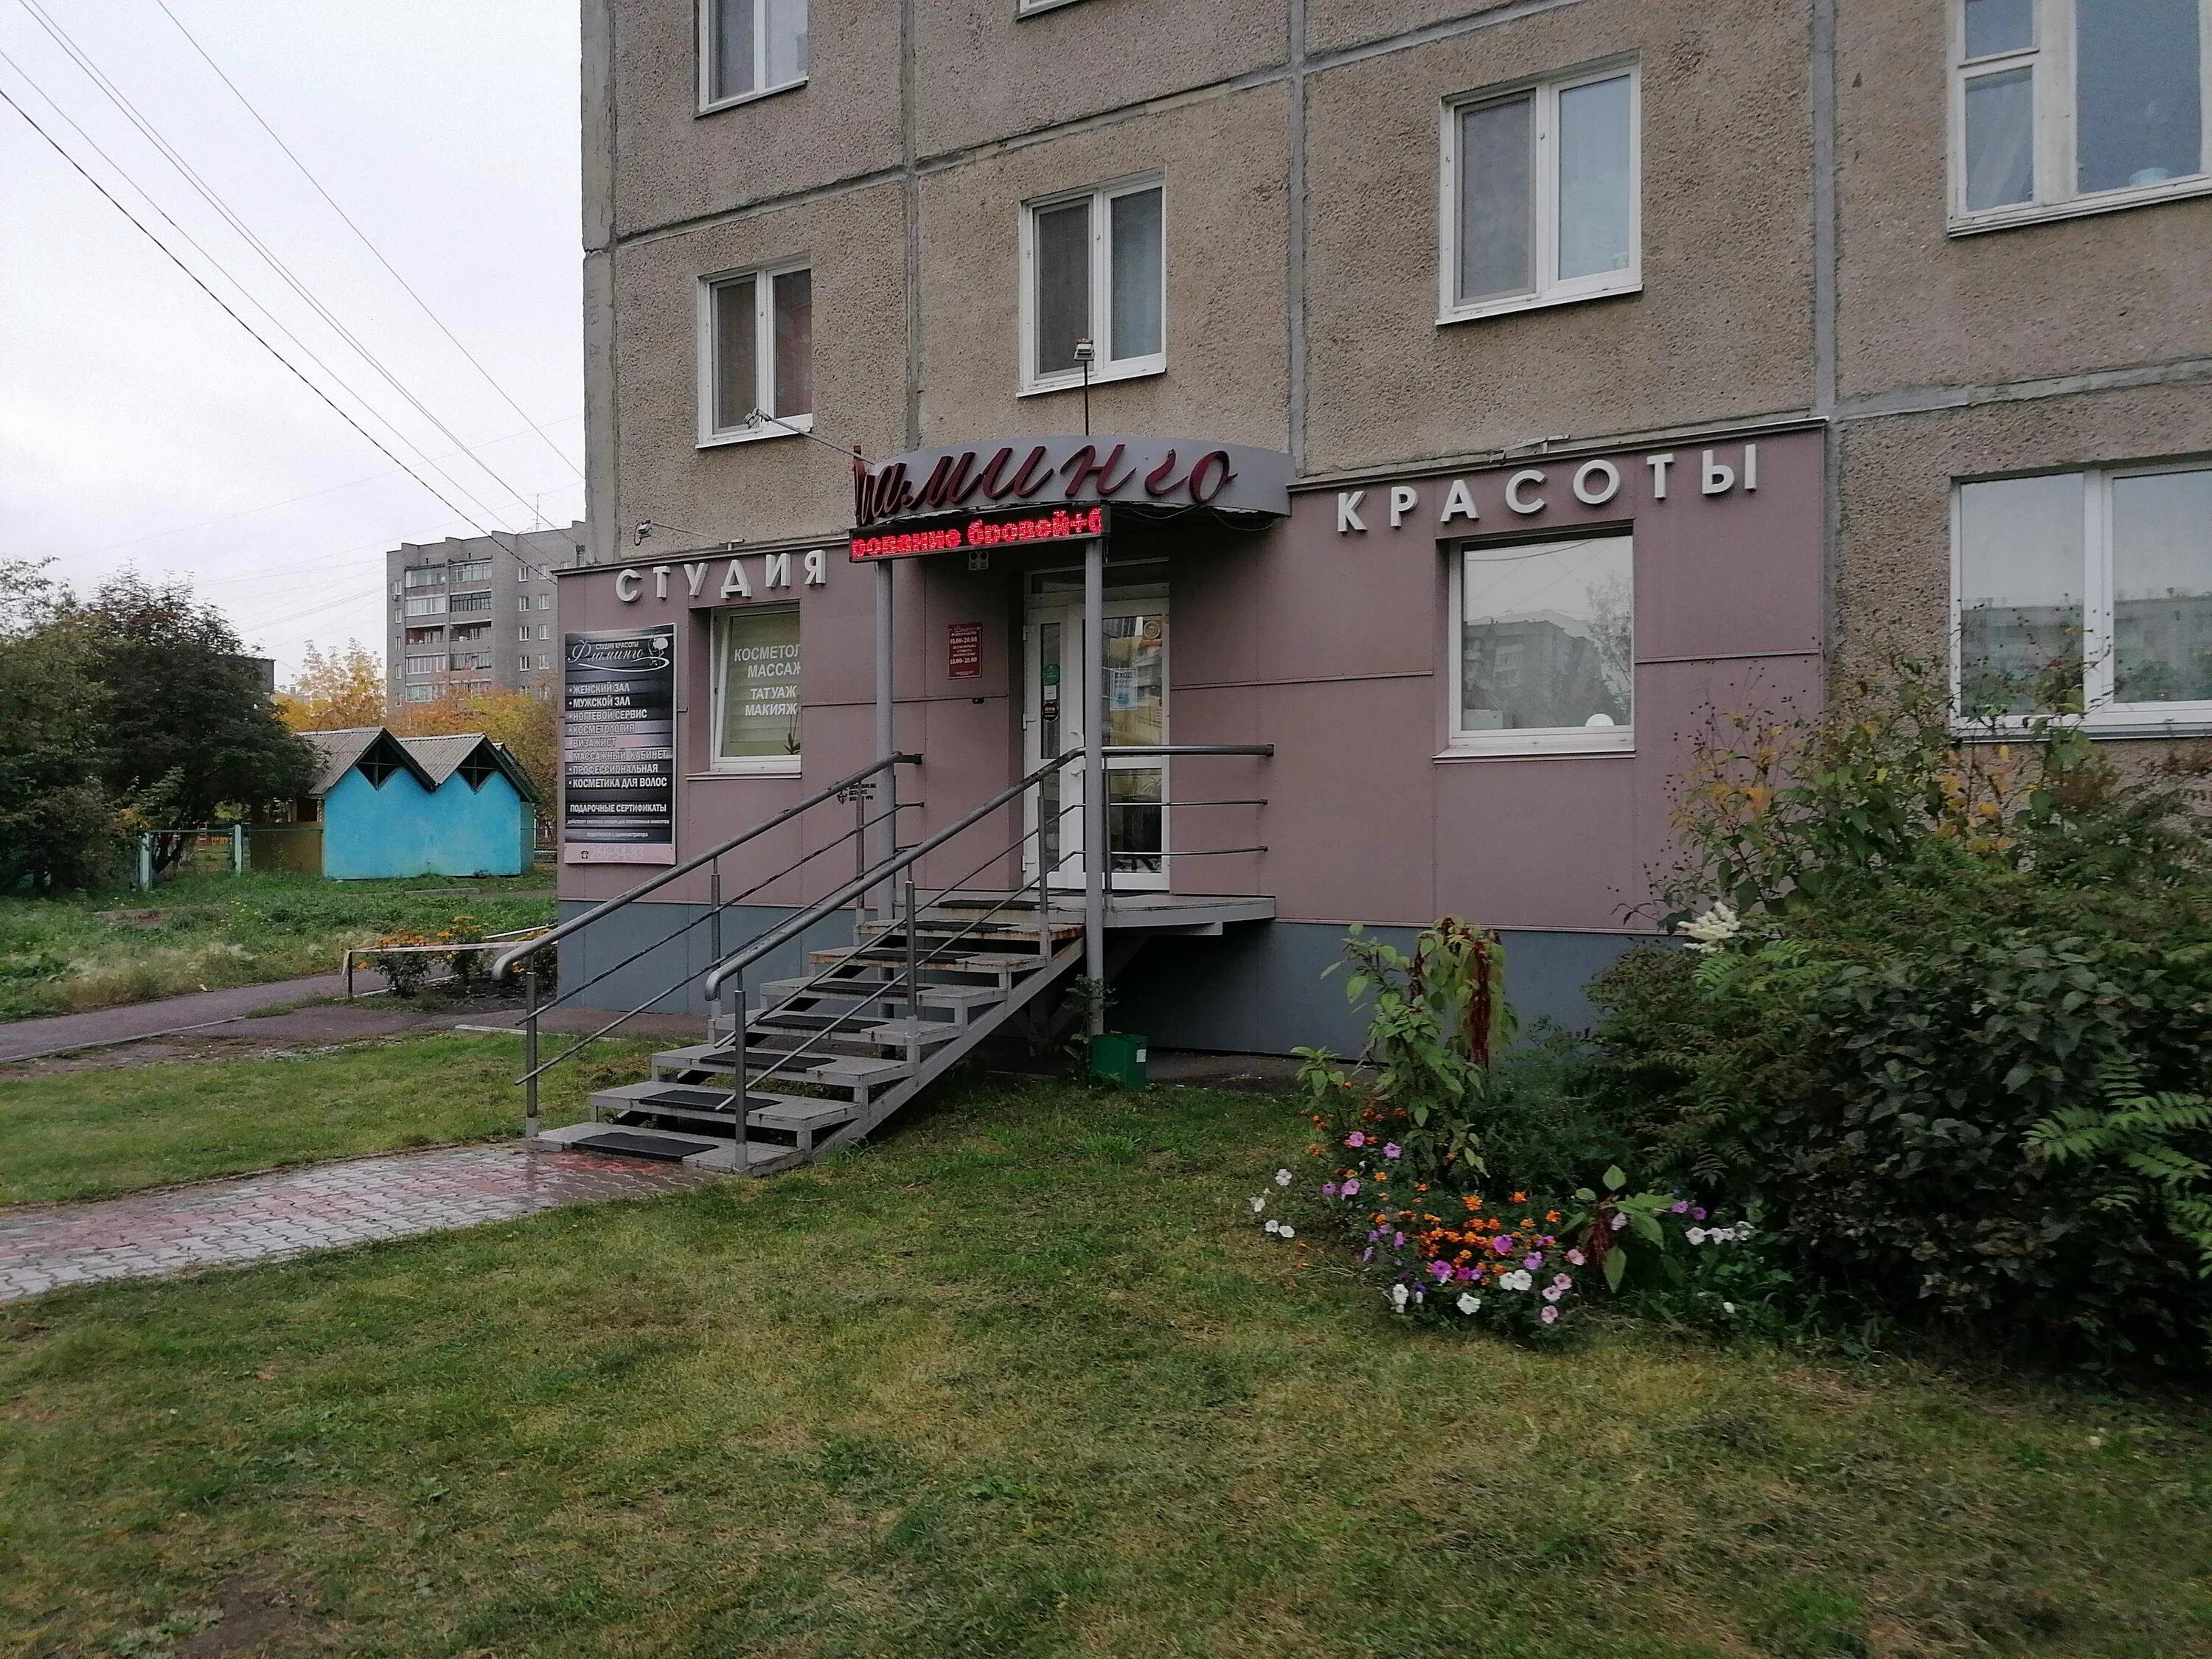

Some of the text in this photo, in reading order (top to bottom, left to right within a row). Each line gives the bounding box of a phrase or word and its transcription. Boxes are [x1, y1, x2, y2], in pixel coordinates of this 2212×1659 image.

[1337, 444, 1758, 533] КРАСОТЫ
[615, 549, 827, 602] СТУДИЯ
[567, 639, 644, 663] Фламинго
[573, 682, 630, 695] ЖЕНСКИЙ ЗАЛ
[751, 685, 797, 700] ТАТУАЖ
[573, 695, 631, 708] МУЖСКОЙ ЗАЛ
[573, 709, 647, 721] НОГТЕВОЙ СЕРВИС
[745, 703, 798, 716] МАКИЯЖ
[573, 723, 636, 734] КОСМЕТОЛОГИЯ
[573, 737, 616, 748] ВИЗАЖИСТ
[573, 748, 667, 761] МАССАЖНЫЙ КАБИНЕТ
[573, 764, 658, 774] ПРОФЕССИОНАЛЬНАЯ
[573, 777, 667, 789] КОСМЕТИКА ДЛЯ ВОЛОС
[570, 804, 667, 813] ПОДАРОЧНЫЕ СЕРТИФИКАТЫ
[590, 846, 644, 860] 266-54-83
